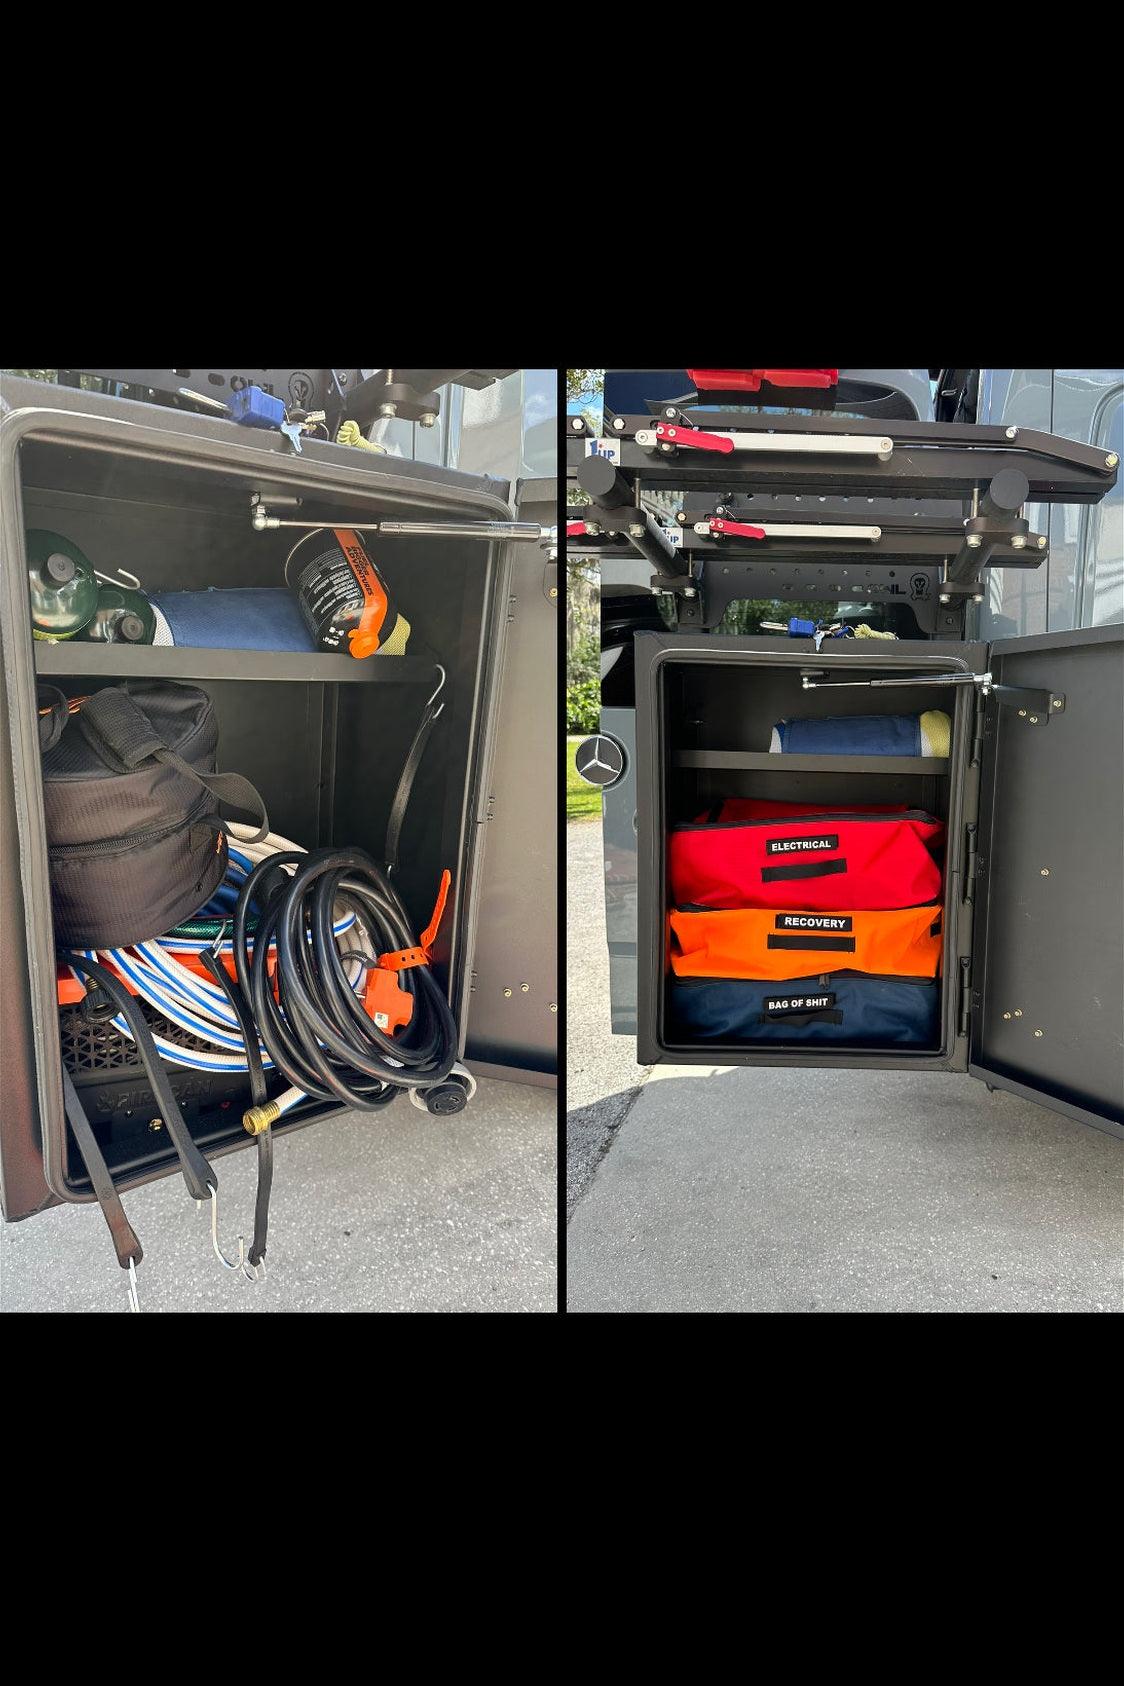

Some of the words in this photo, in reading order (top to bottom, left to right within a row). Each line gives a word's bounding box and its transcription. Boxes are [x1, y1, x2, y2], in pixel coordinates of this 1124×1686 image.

[345, 547, 373, 595] ADVENTURES
[772, 840, 831, 851] ELECTRICAL
[785, 917, 845, 928] RECOVERY
[768, 1000, 790, 1010] BAG
[792, 999, 803, 1007] OF
[806, 998, 828, 1007] SHIT
